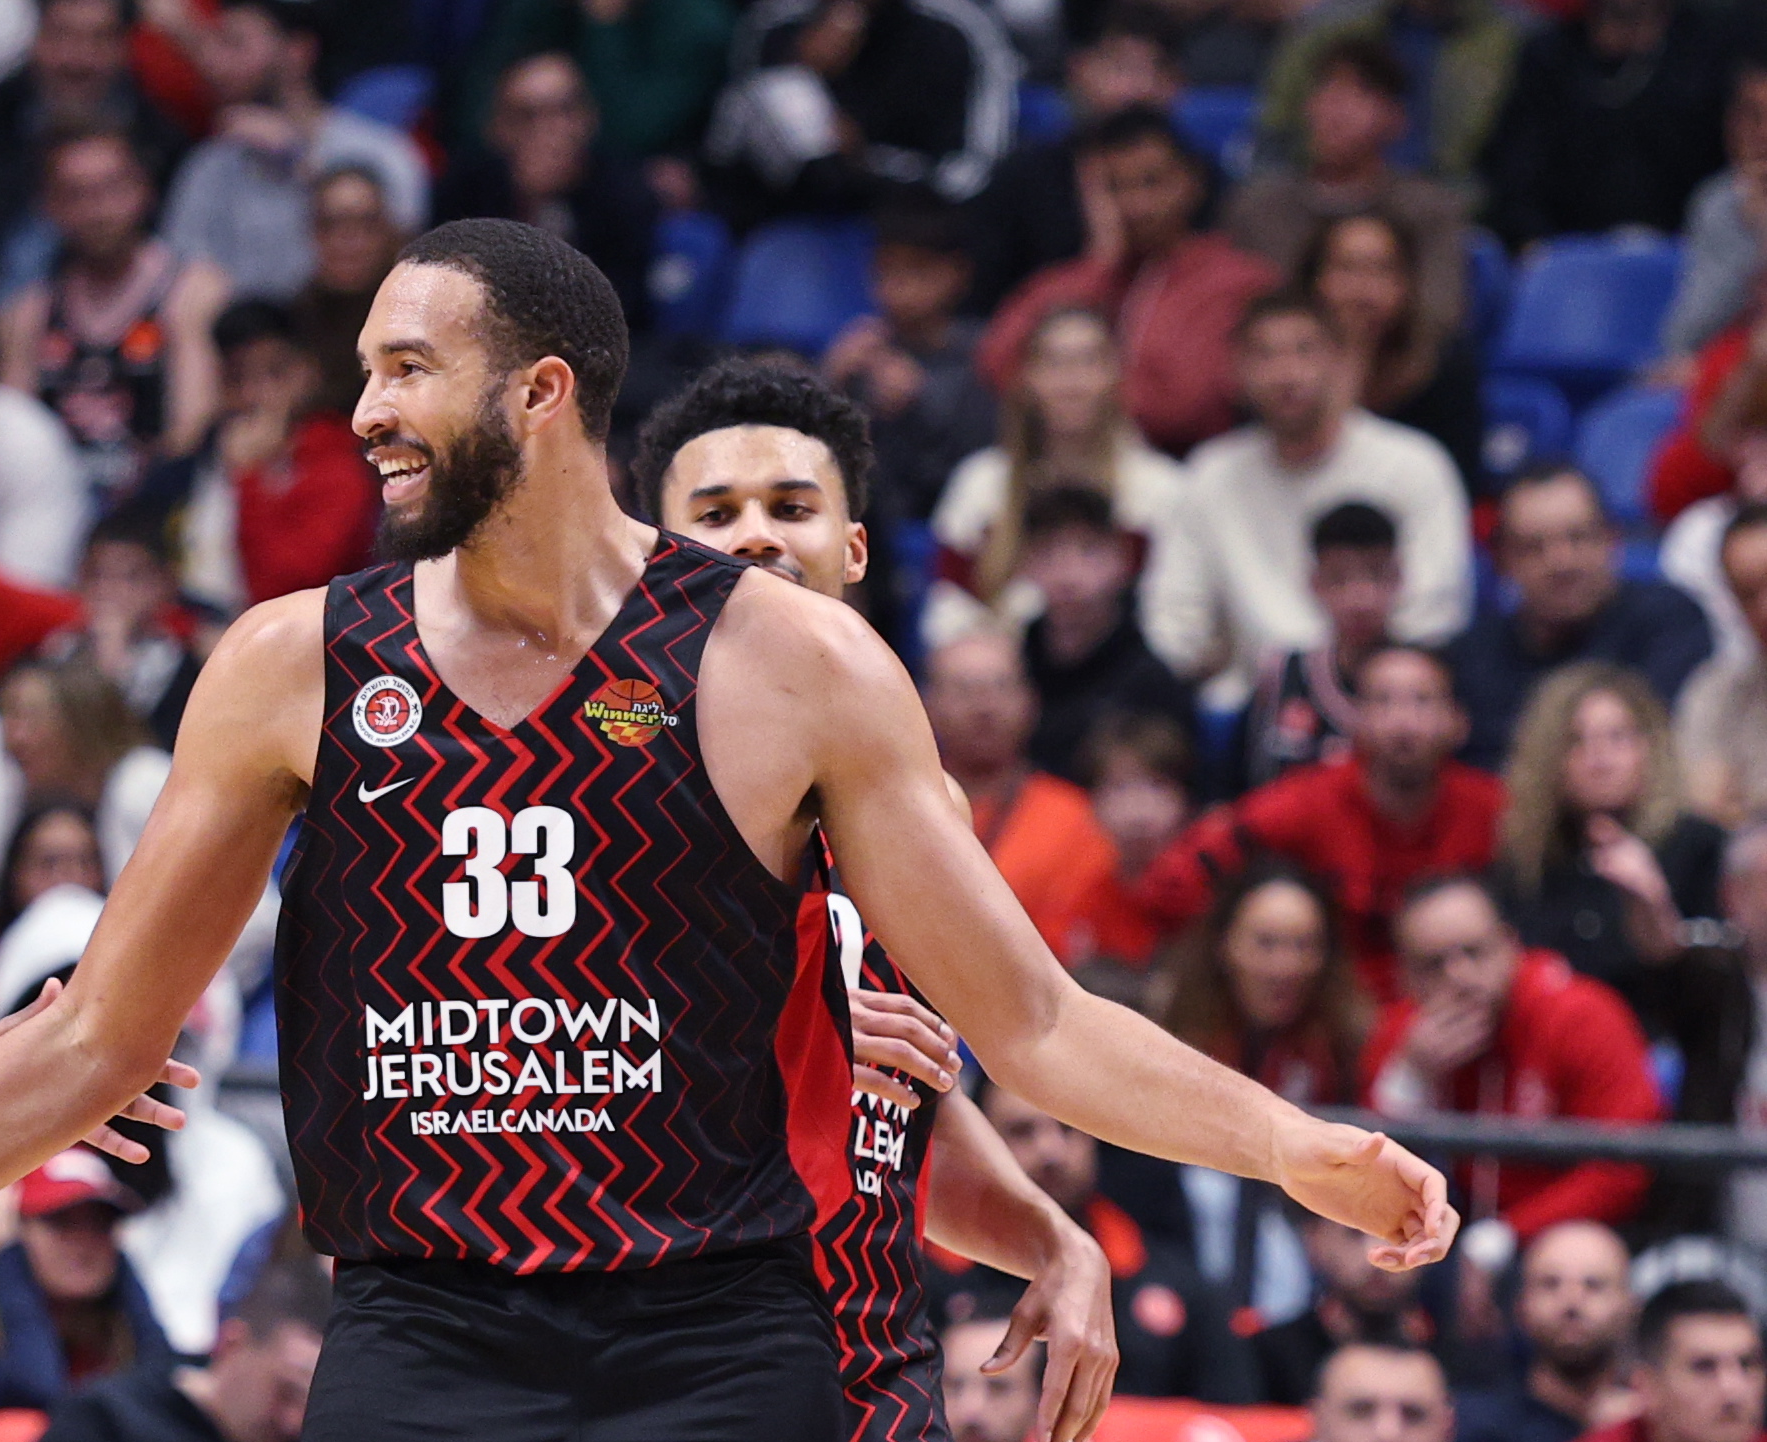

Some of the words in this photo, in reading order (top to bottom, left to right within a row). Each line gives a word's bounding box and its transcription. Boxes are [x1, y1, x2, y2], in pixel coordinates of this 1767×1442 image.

[632, 701, 660, 713] ליגת
[660, 711, 678, 727] סל
[441, 805, 577, 939] 33
[365, 997, 661, 1048] MIDTOWN
[363, 1048, 662, 1100] JERUSALEM
[853, 1114, 907, 1172] LEM
